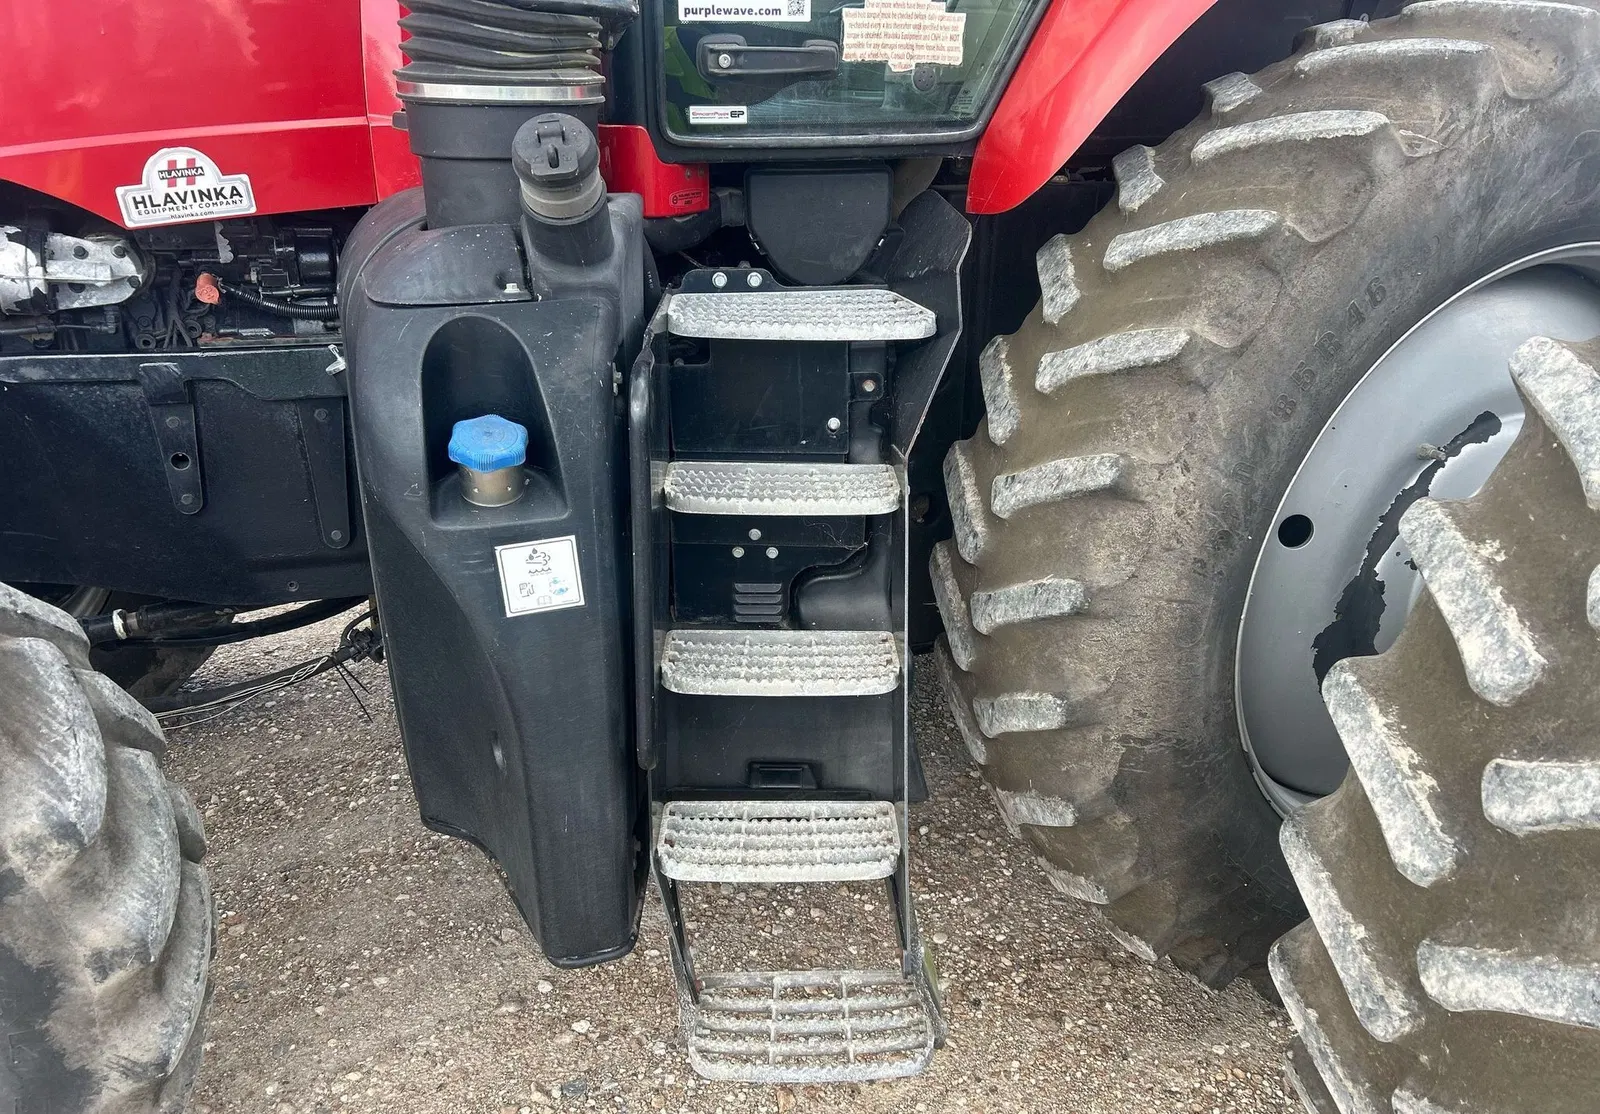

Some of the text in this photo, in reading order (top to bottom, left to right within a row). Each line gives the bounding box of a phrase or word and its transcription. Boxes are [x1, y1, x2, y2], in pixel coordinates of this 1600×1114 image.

[683, 5, 782, 18] purplewave.com
[730, 110, 745, 118] EP
[158, 166, 205, 180] HLAVINKA
[132, 185, 244, 210] HLAVINKA
[137, 199, 244, 216] EQUIPMENT COMPANY
[170, 210, 215, 220] hlavinka.com
